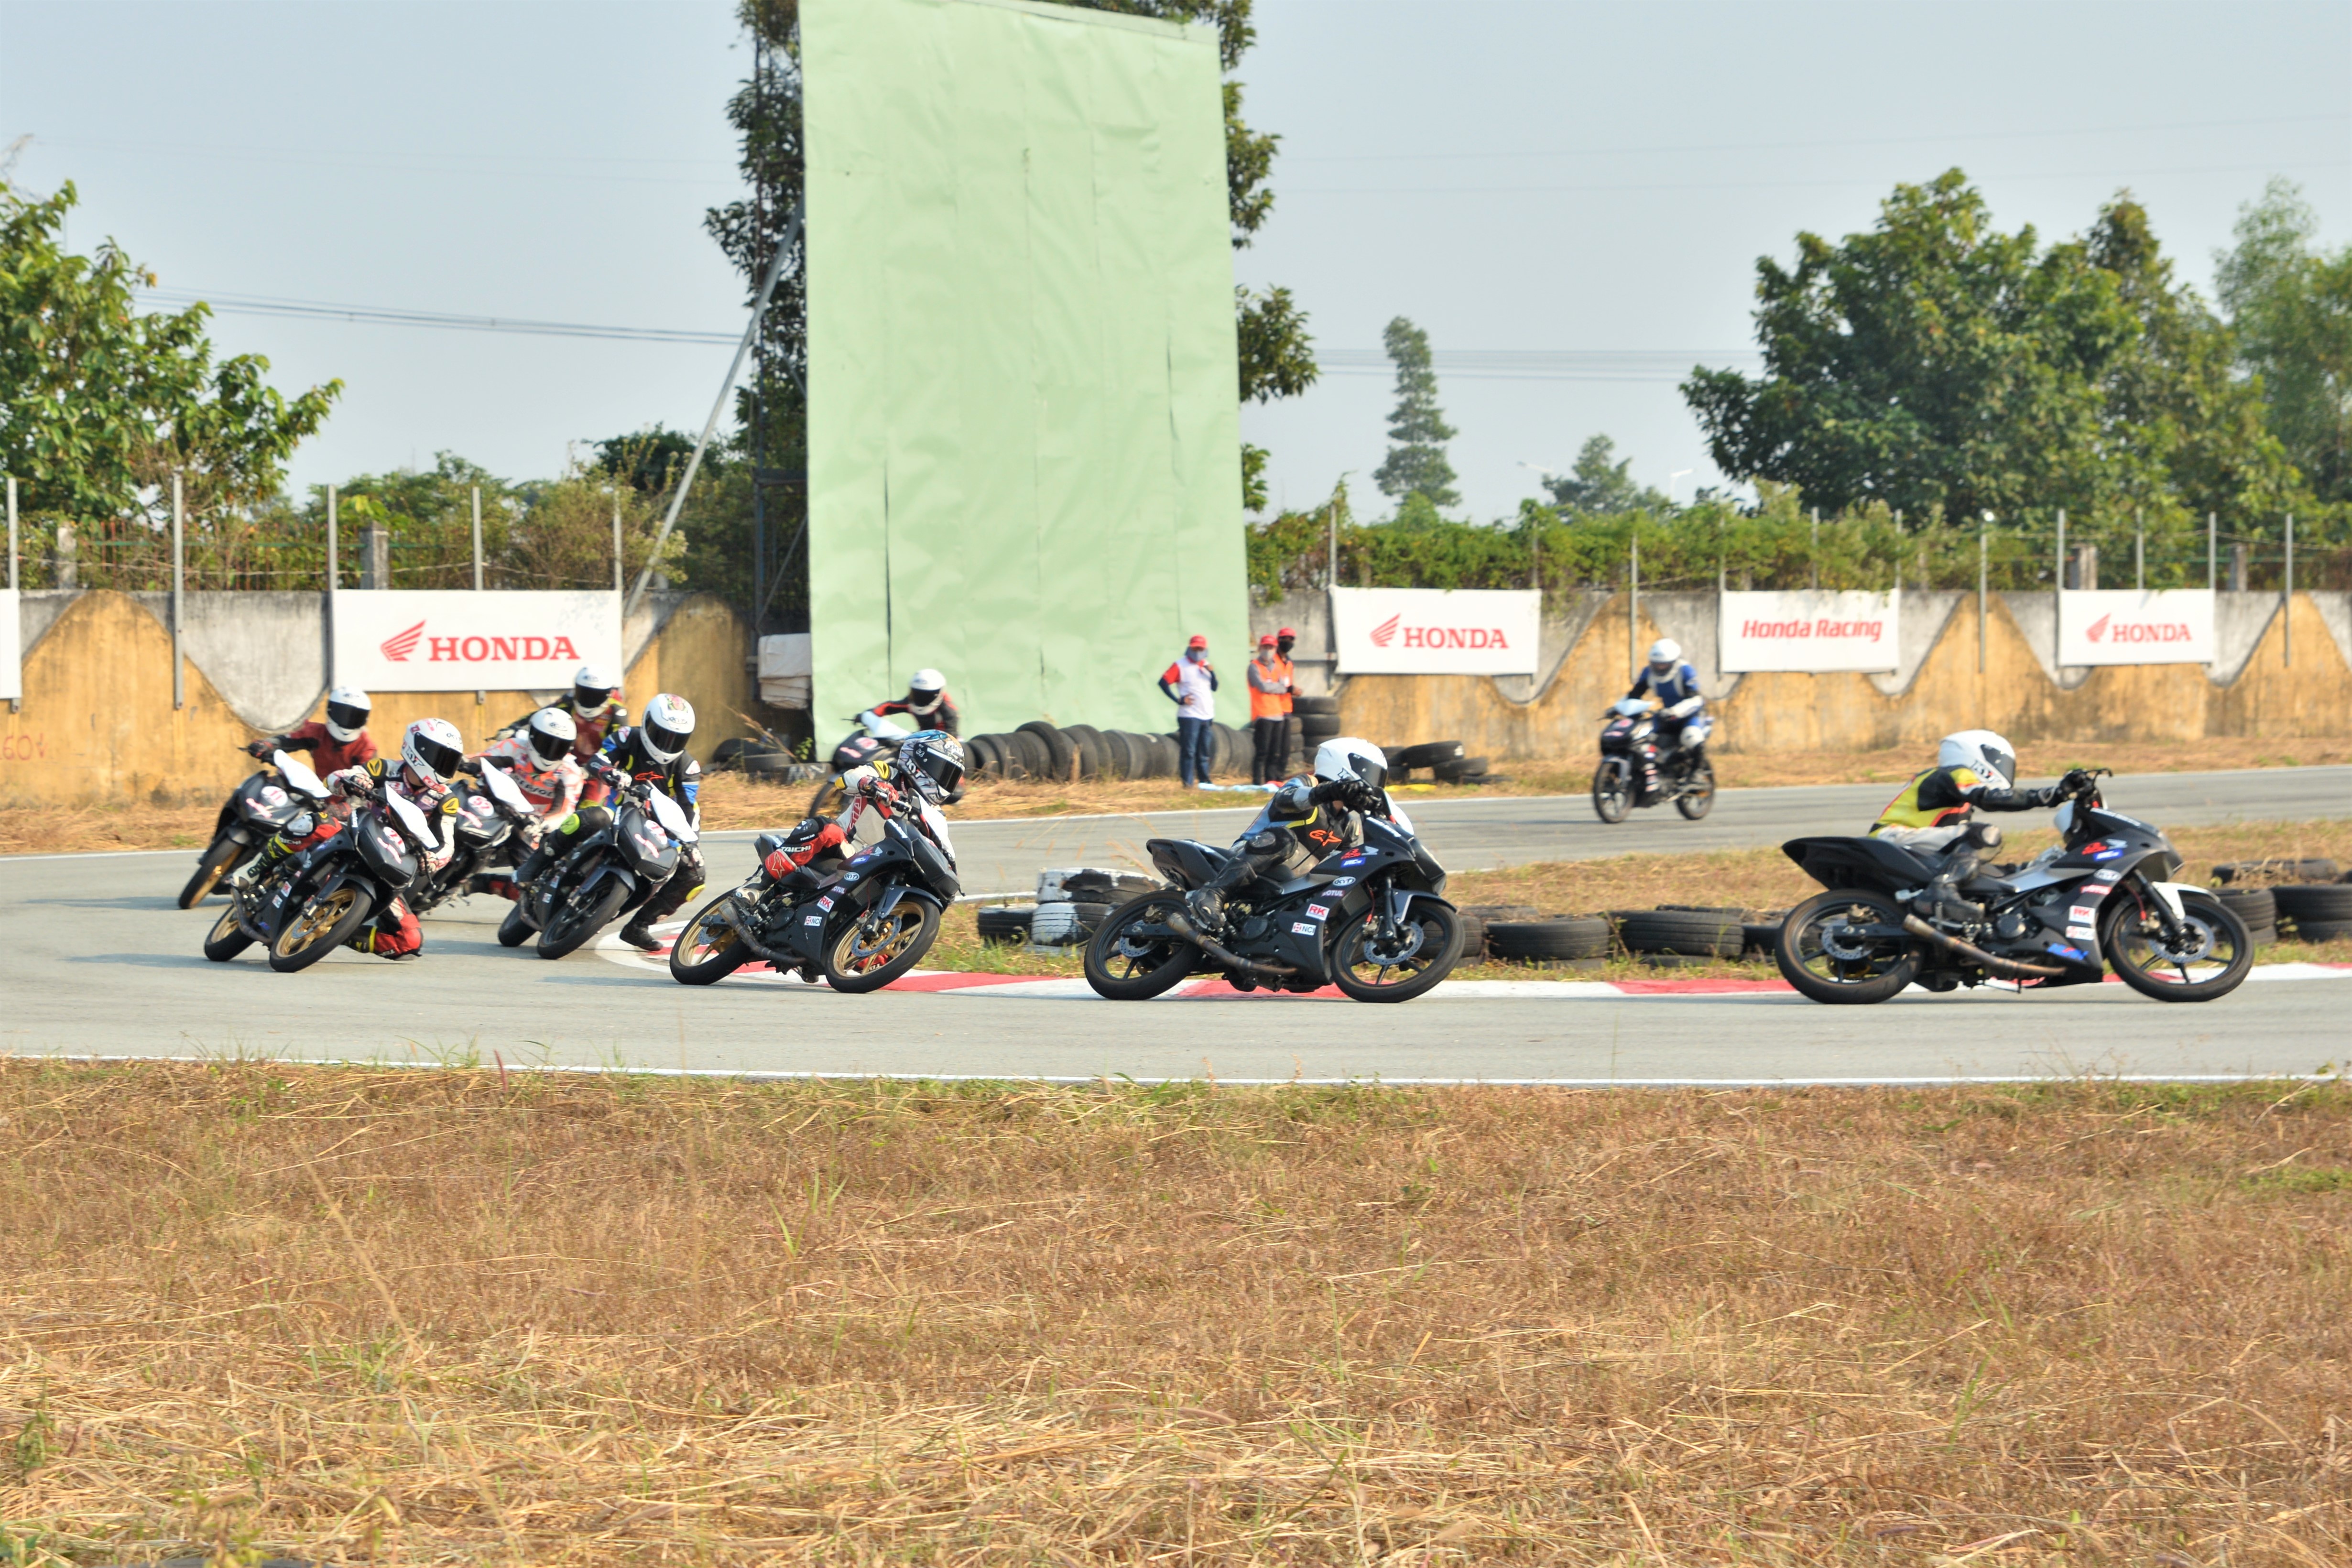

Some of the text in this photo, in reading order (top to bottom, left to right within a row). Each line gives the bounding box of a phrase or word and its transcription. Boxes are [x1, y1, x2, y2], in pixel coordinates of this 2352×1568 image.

[1403, 627, 1509, 649] HONDA
[1742, 619, 1883, 642] Honda Racing
[2112, 623, 2192, 642] HONDA
[428, 636, 581, 662] HONDA
[820, 896, 832, 908] RK
[1308, 905, 1327, 916] RK
